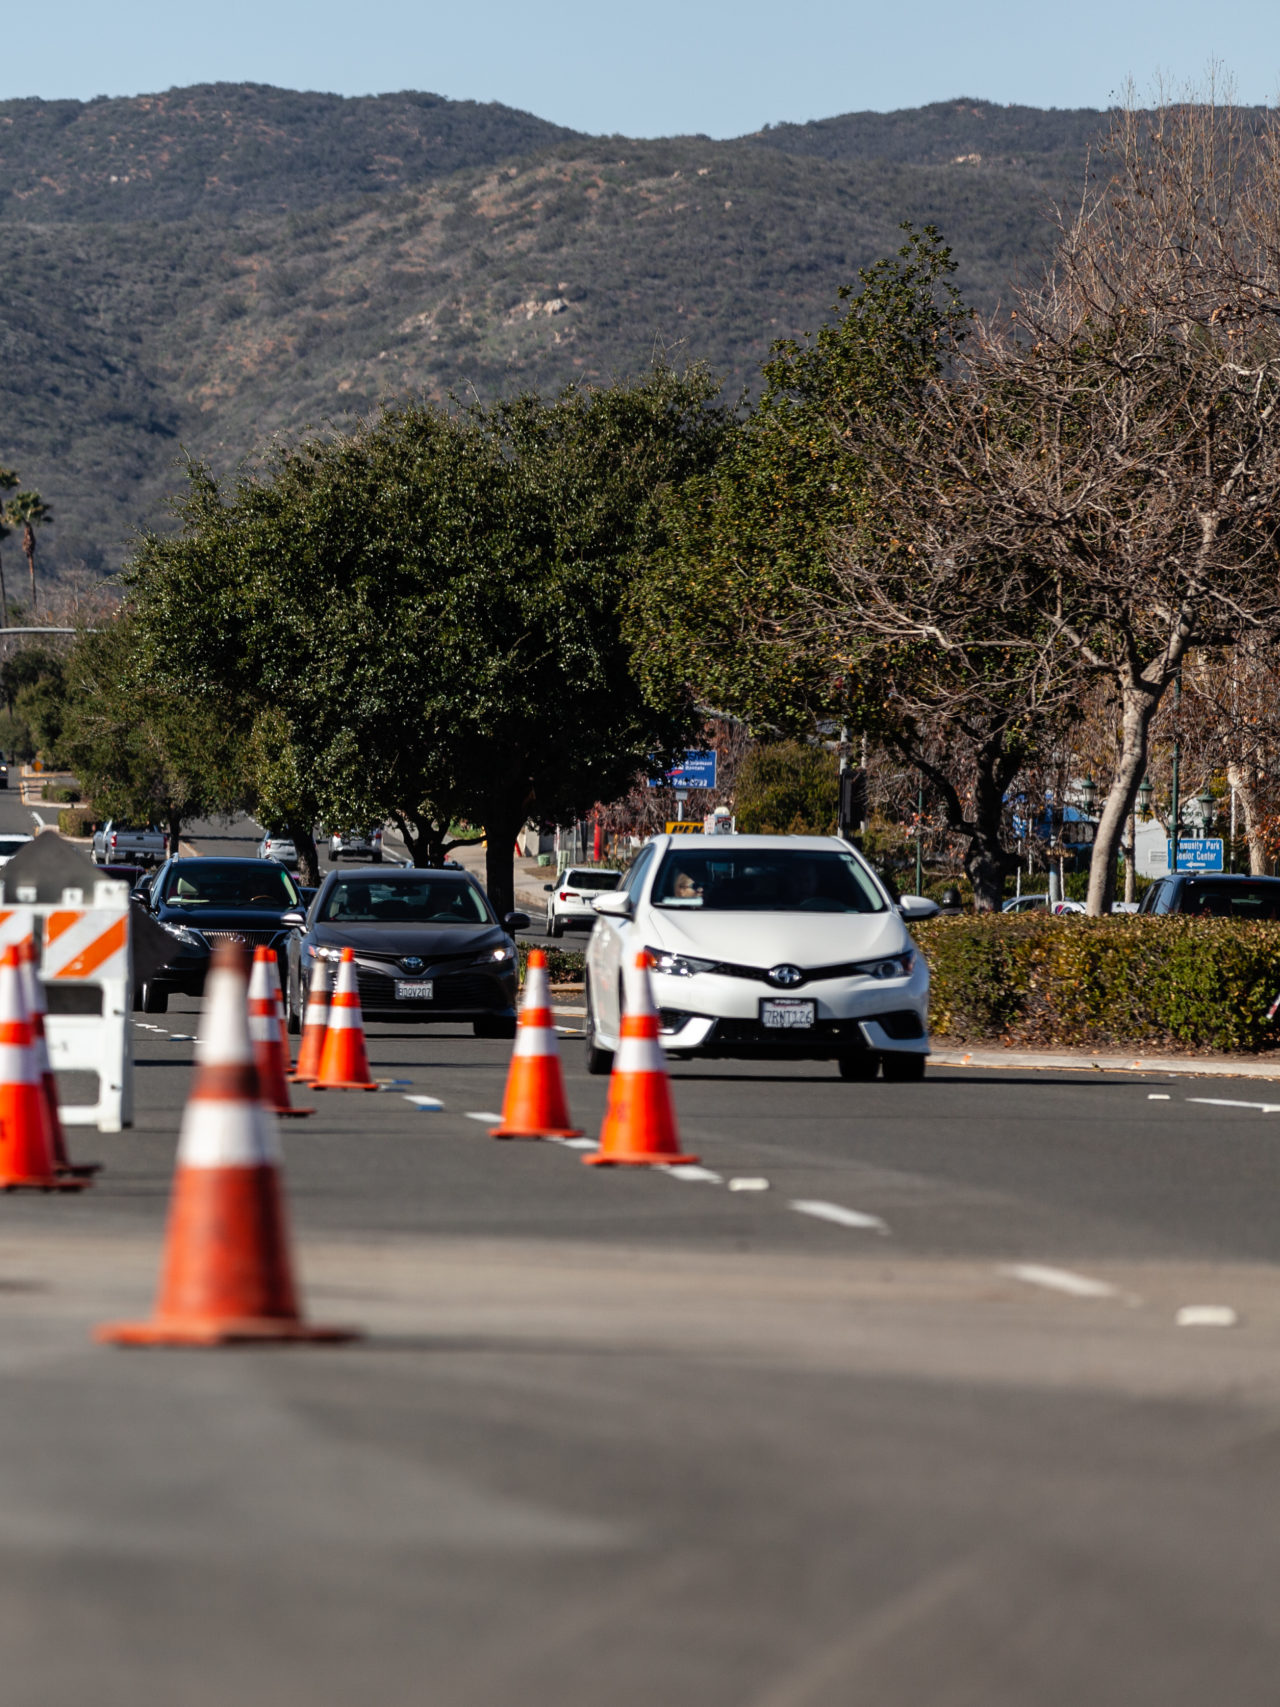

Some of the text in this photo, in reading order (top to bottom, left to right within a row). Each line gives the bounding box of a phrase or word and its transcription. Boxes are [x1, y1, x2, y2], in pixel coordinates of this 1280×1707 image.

[1205, 840, 1220, 850] Park
[1196, 851, 1217, 861] Center
[765, 1010, 812, 1024] 7RNT126
